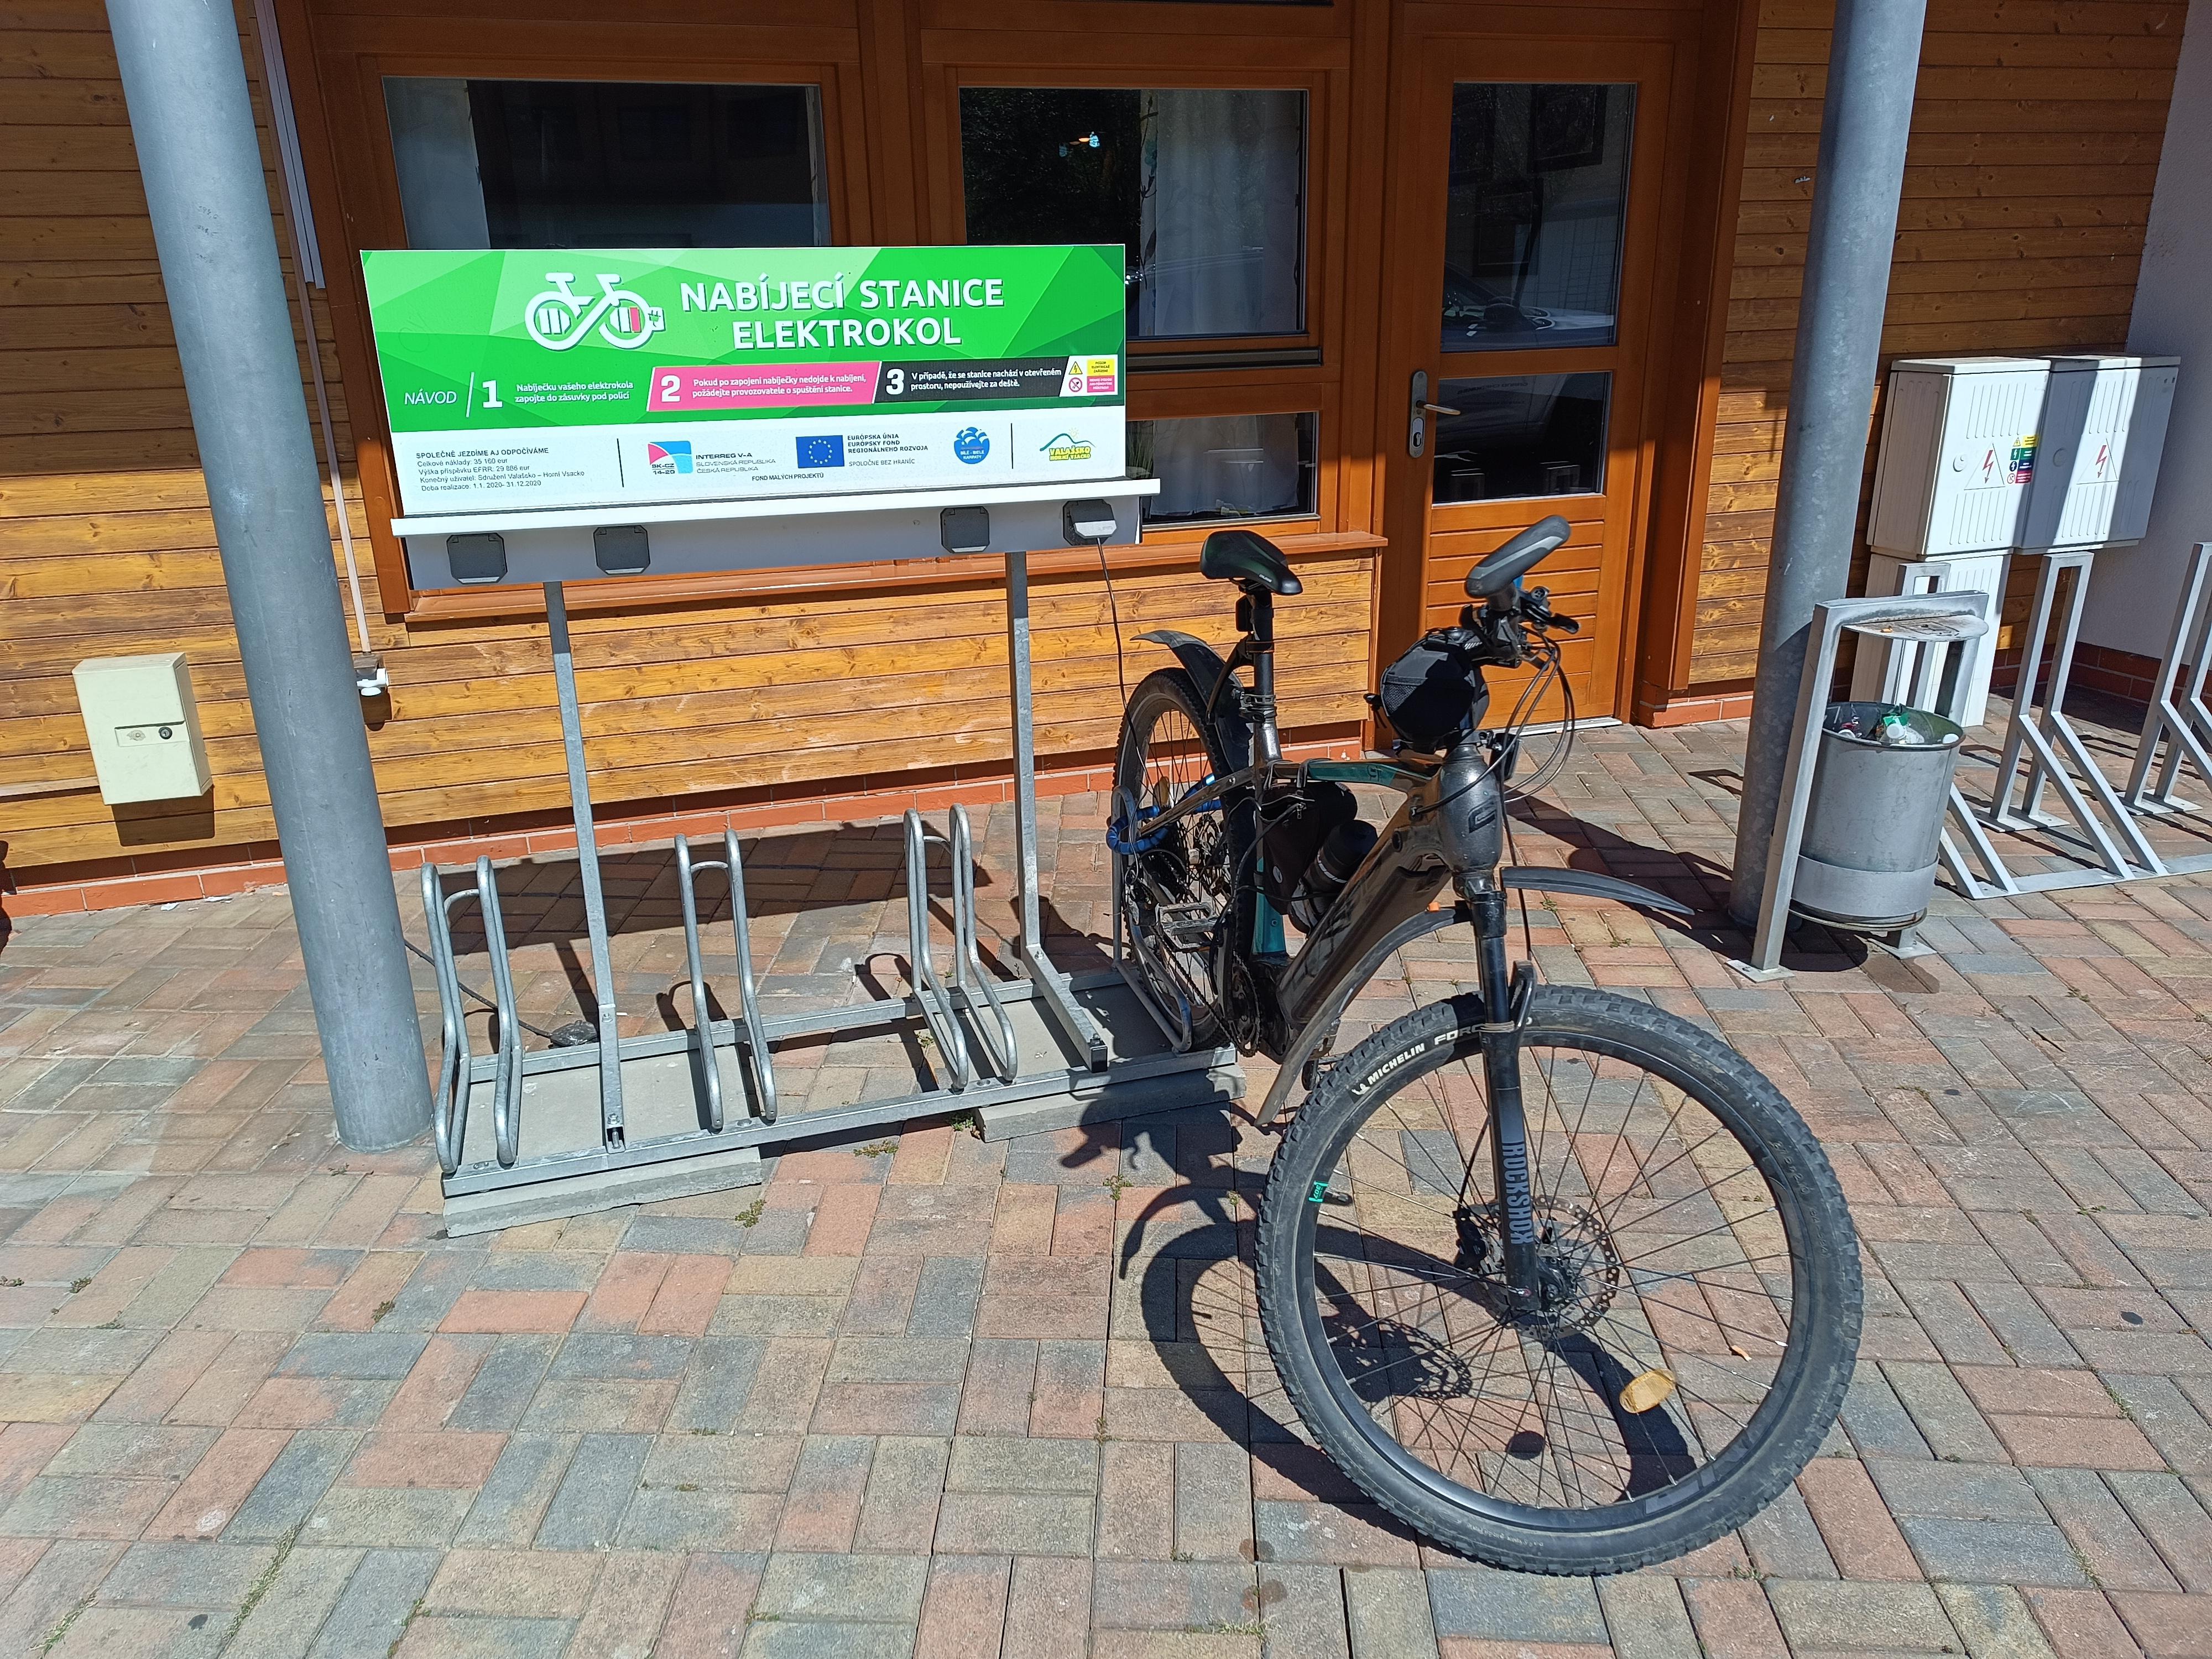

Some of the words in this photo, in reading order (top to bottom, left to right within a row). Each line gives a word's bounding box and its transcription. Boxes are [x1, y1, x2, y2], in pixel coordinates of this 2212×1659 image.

[679, 272, 845, 312] NABÍJECÍ
[859, 278, 1004, 309] STANICE
[732, 316, 962, 349] ELEKTROKOL
[693, 378, 718, 387] Pokud
[719, 379, 729, 387] po
[763, 376, 798, 386] nabíječky
[799, 374, 828, 384] nedojde
[886, 368, 905, 395] 3
[919, 371, 947, 381] případě,
[967, 369, 992, 378] stanice
[1025, 368, 1061, 377] otevřeném
[516, 383, 557, 393] Nabíječku
[557, 382, 587, 390] vašeho
[588, 380, 633, 390] elektrokola
[661, 374, 680, 403] 2
[692, 388, 730, 398] požádejte
[731, 387, 785, 398] provozovatele
[792, 385, 823, 395] spuštění
[825, 385, 852, 393] stanice.
[910, 382, 943, 392] prostoru,
[944, 380, 988, 390] nepoužívejte
[404, 389, 457, 405] NÁVOD
[482, 379, 503, 408] 1
[515, 394, 546, 404] zapojte
[547, 394, 557, 402] do
[558, 393, 590, 403] zásuvky
[592, 392, 607, 401] pod
[416, 450, 456, 459] SPOLEČNĚ
[501, 447, 549, 455] ODPOČÍVÁME
[1049, 445, 1091, 456] VALAŠSKO
[1367, 1043, 1425, 1085] MICHELIN
[1313, 1185, 1321, 1199] 307
[1502, 1144, 1534, 1244] ROCKSHOX
